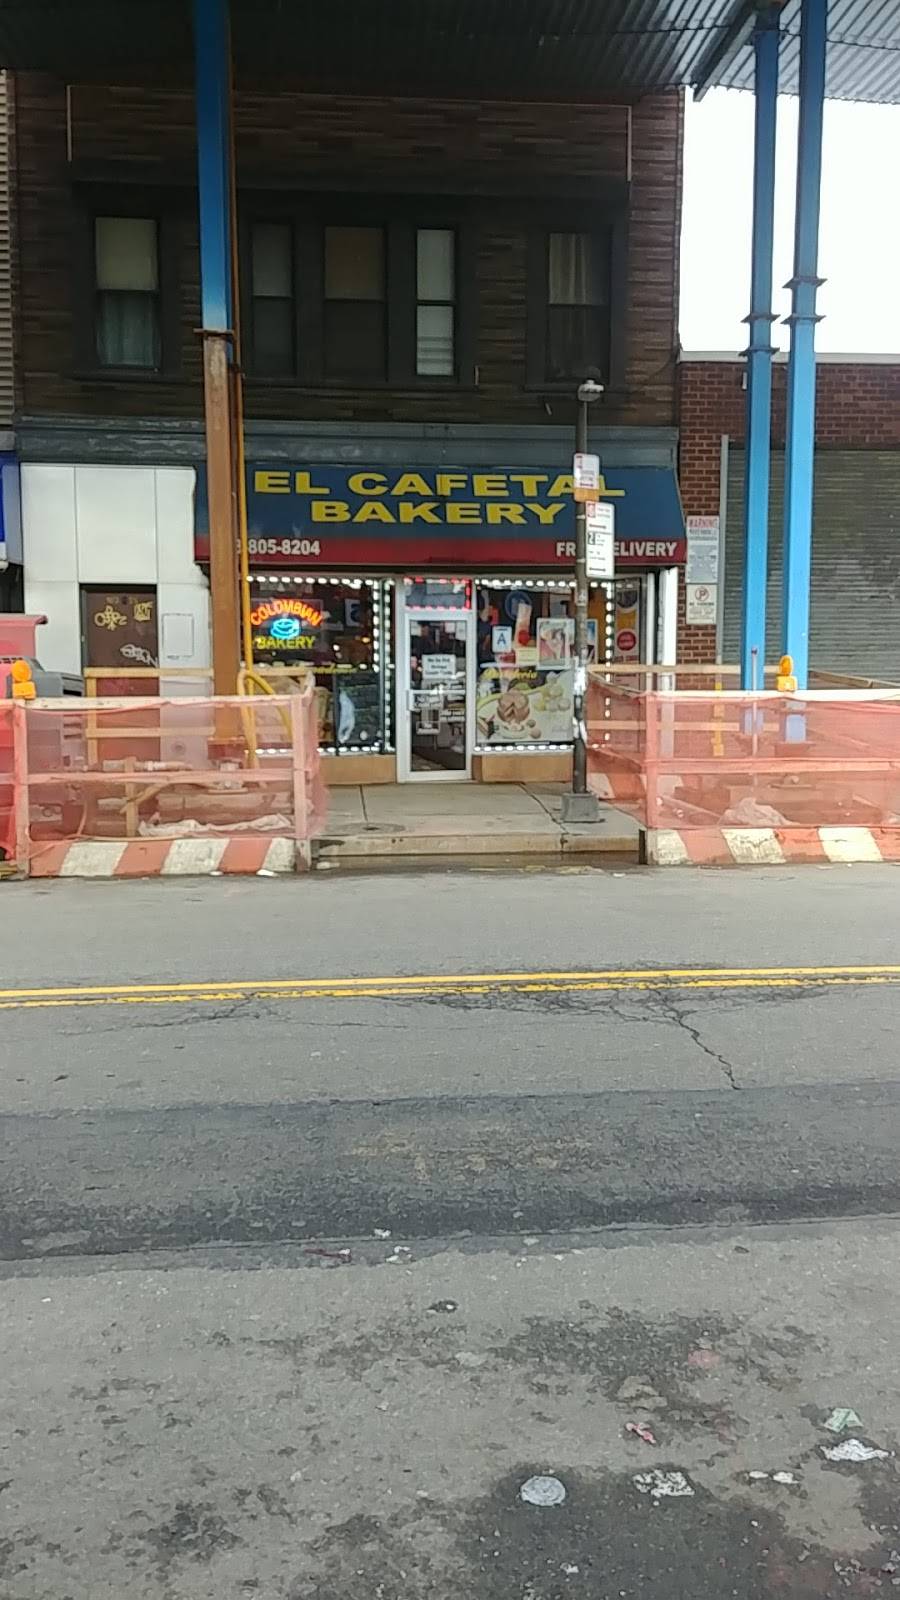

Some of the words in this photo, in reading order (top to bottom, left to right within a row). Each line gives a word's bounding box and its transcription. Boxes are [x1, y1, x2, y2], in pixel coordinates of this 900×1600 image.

[254, 470, 330, 495] EL
[348, 472, 626, 498] CAFETAL
[311, 501, 566, 525] BAKERY
[556, 541, 577, 557] FR
[613, 541, 678, 559] ELIVERY
[250, 598, 324, 627] COLOMBIAN
[256, 635, 317, 650] BAKERY
[496, 631, 508, 646] A
